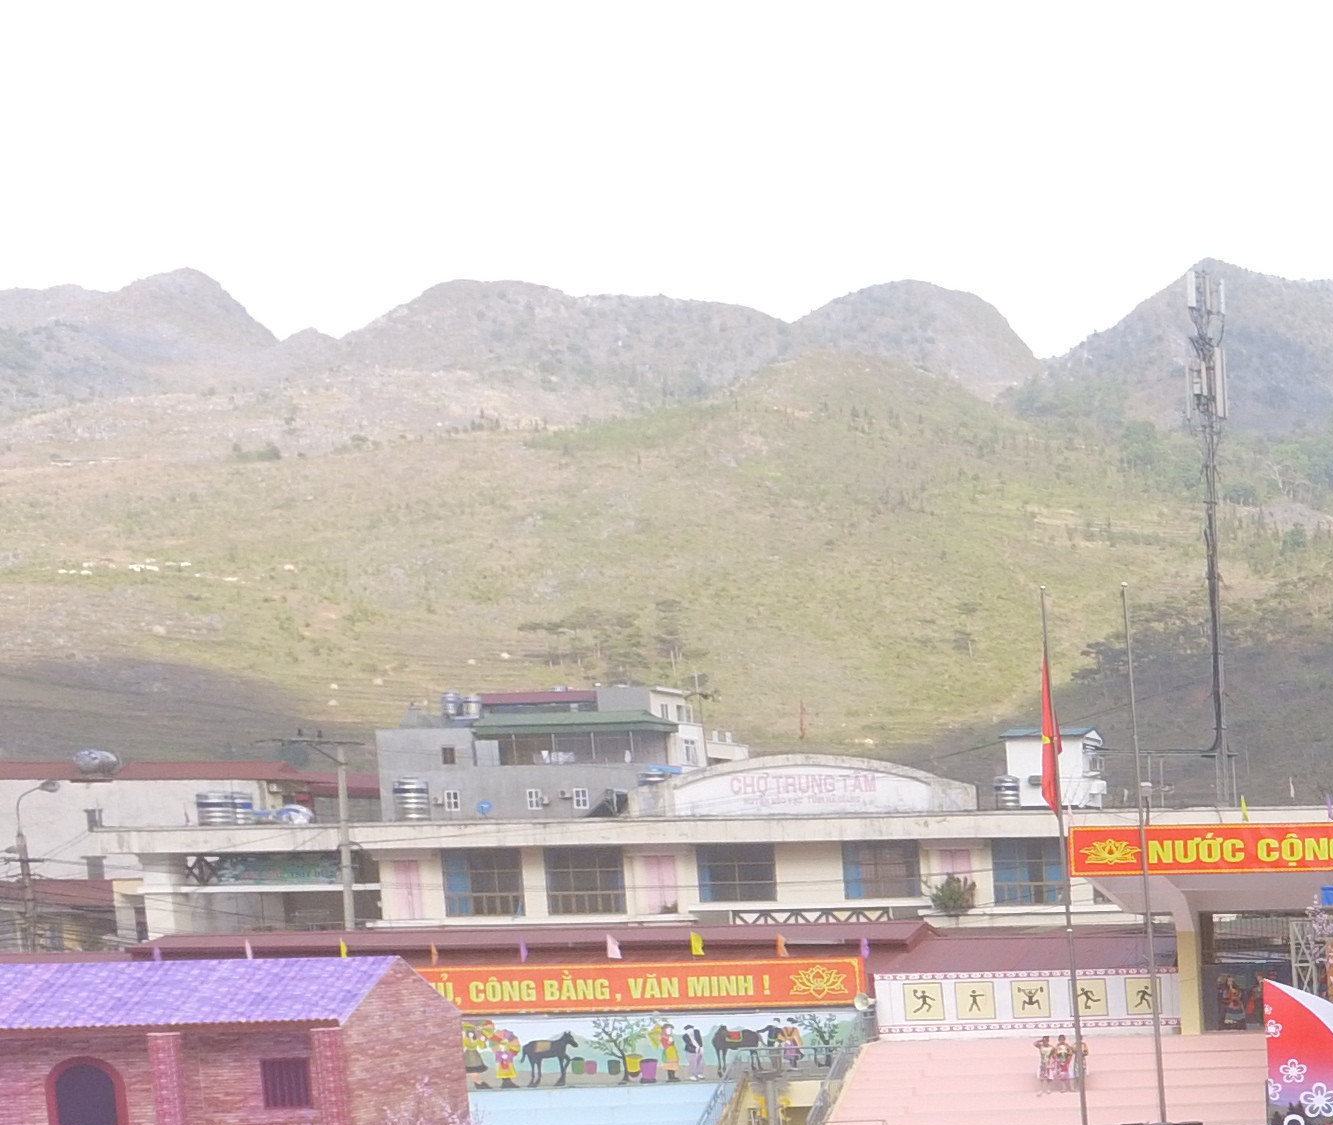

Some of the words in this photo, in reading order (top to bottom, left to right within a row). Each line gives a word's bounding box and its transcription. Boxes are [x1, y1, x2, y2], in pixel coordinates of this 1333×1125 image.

[730, 772, 770, 798] CHỢ
[772, 774, 836, 794] TRUNG
[838, 770, 877, 793] TÂM
[1148, 832, 1245, 864] NƯỚC
[469, 976, 537, 1003] CÔNG
[627, 973, 680, 999] VĂN
[687, 975, 755, 998] MINH
